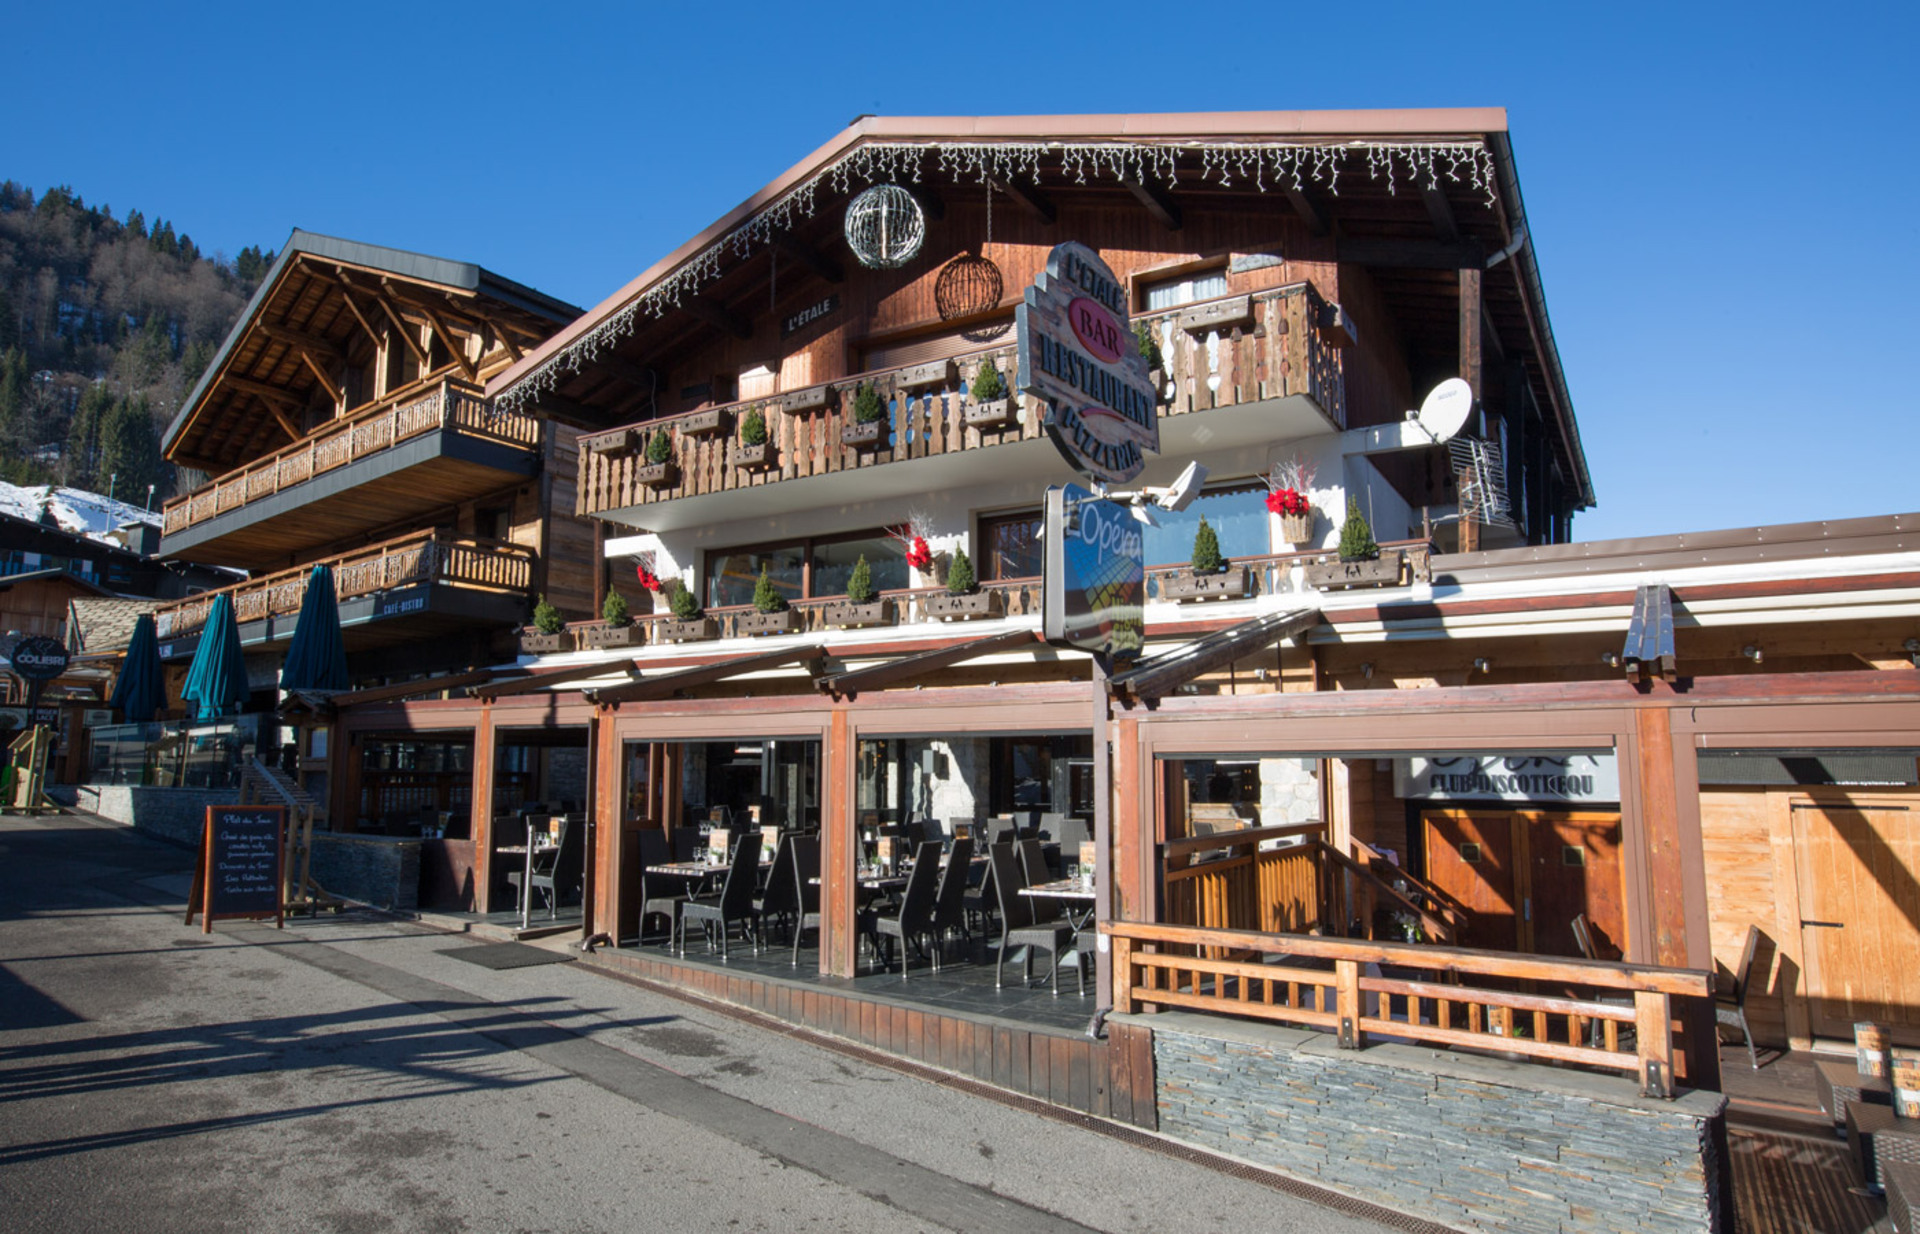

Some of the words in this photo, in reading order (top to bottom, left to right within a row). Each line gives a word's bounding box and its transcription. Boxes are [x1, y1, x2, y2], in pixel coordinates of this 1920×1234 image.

[1079, 306, 1120, 357] BAR
[1040, 333, 1153, 430] RESTAURANT
[1062, 406, 1142, 471] PIZZERIA
[1066, 493, 1142, 565] L'Opéra
[16, 654, 66, 666] COLIBRI
[1430, 774, 1472, 793] CLUB
